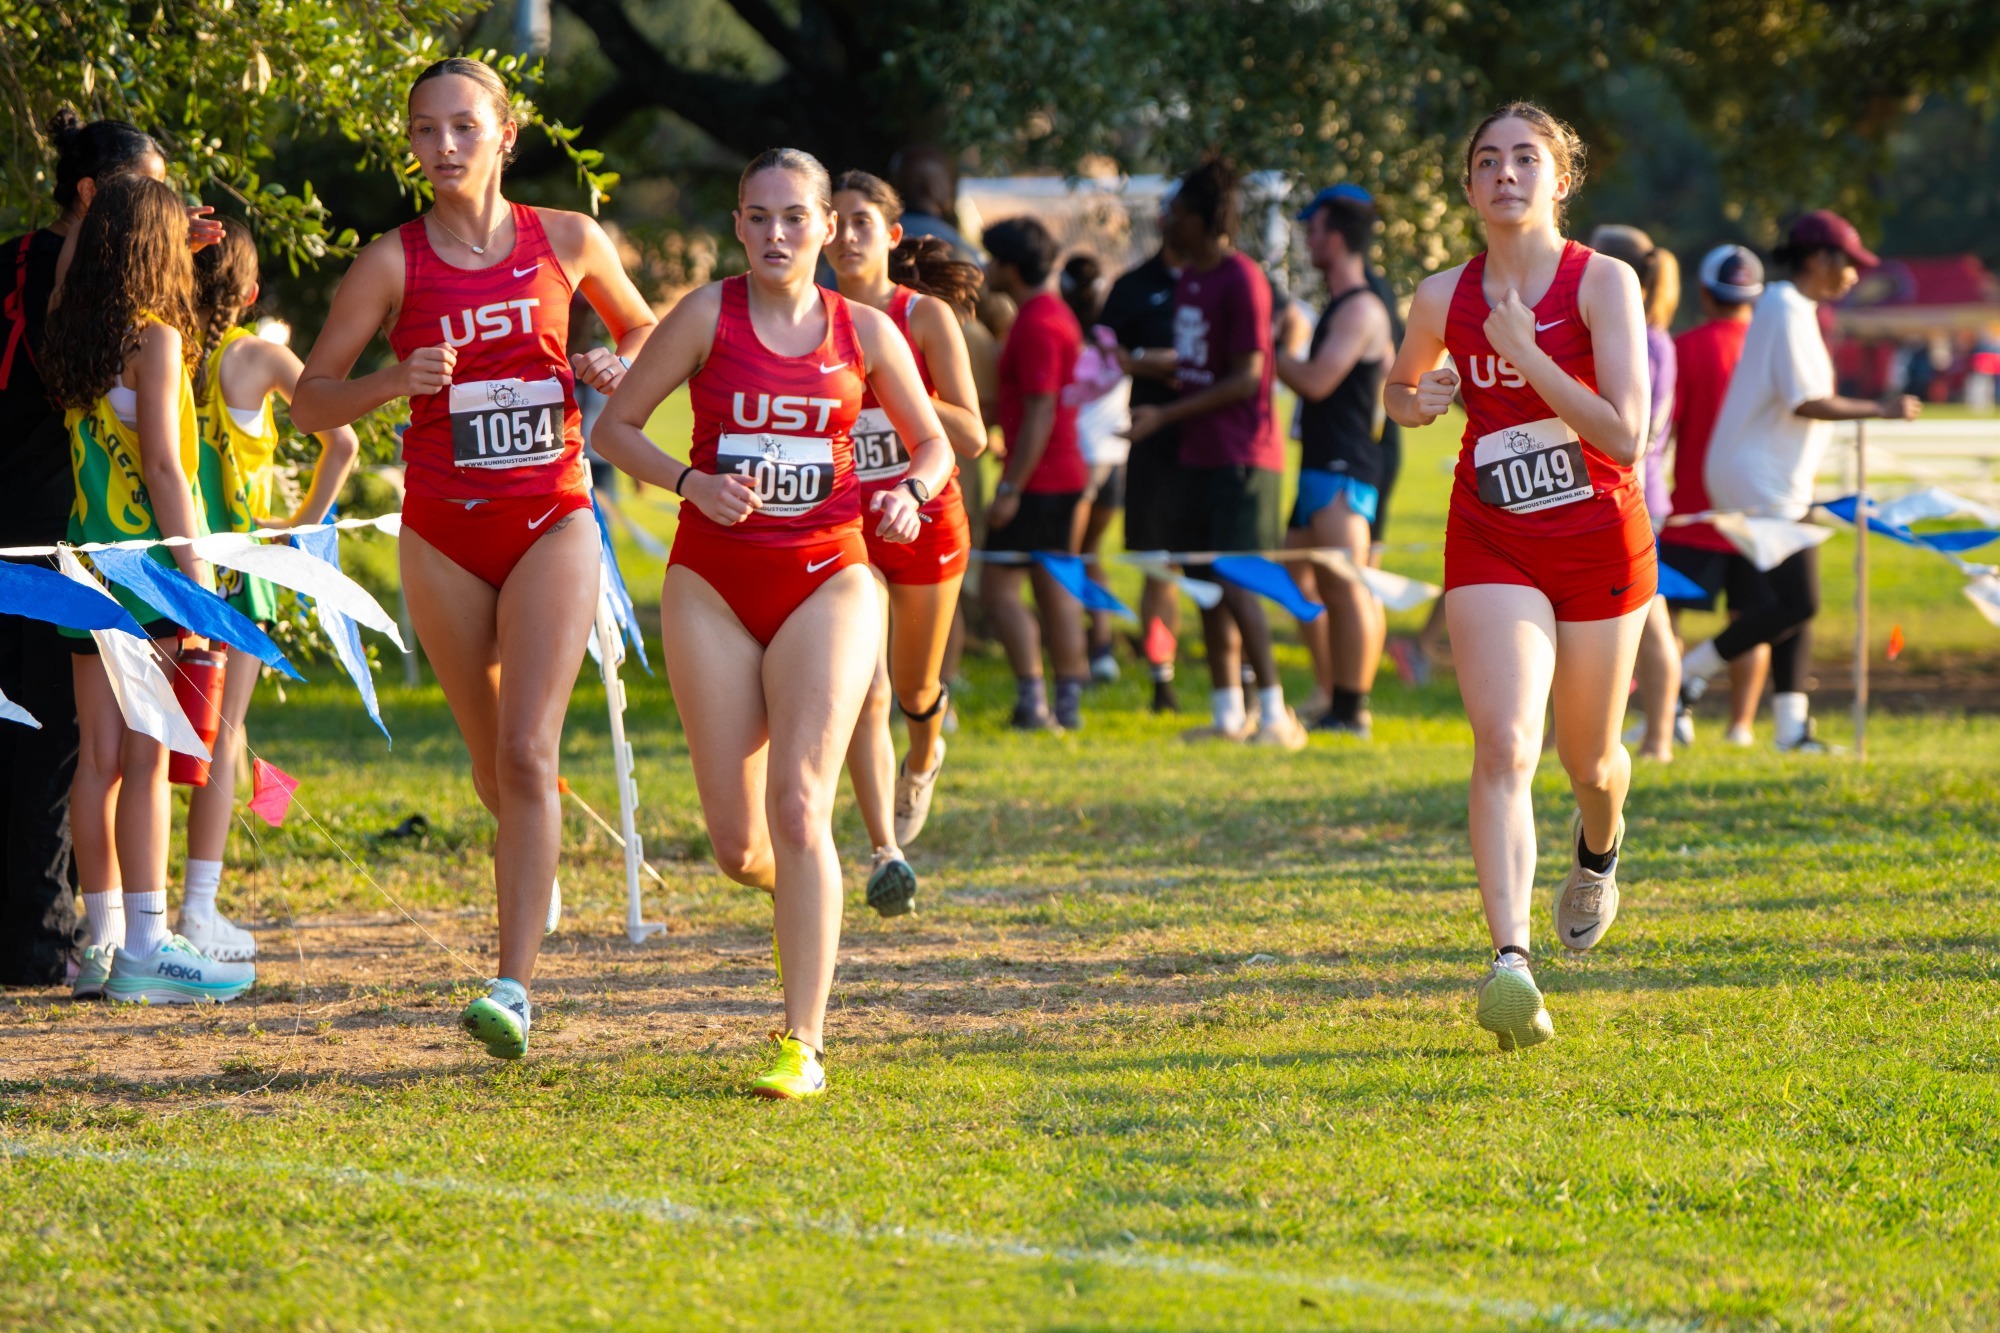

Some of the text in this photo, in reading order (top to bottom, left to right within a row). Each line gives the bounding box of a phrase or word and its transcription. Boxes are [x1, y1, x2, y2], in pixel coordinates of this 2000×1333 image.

[440, 298, 540, 347] UST
[1470, 355, 1552, 388] US
[469, 408, 555, 455] 1054
[733, 392, 842, 432] UST
[854, 433, 899, 469] 051
[1491, 449, 1575, 503] 1049
[157, 962, 202, 981] HOKA
